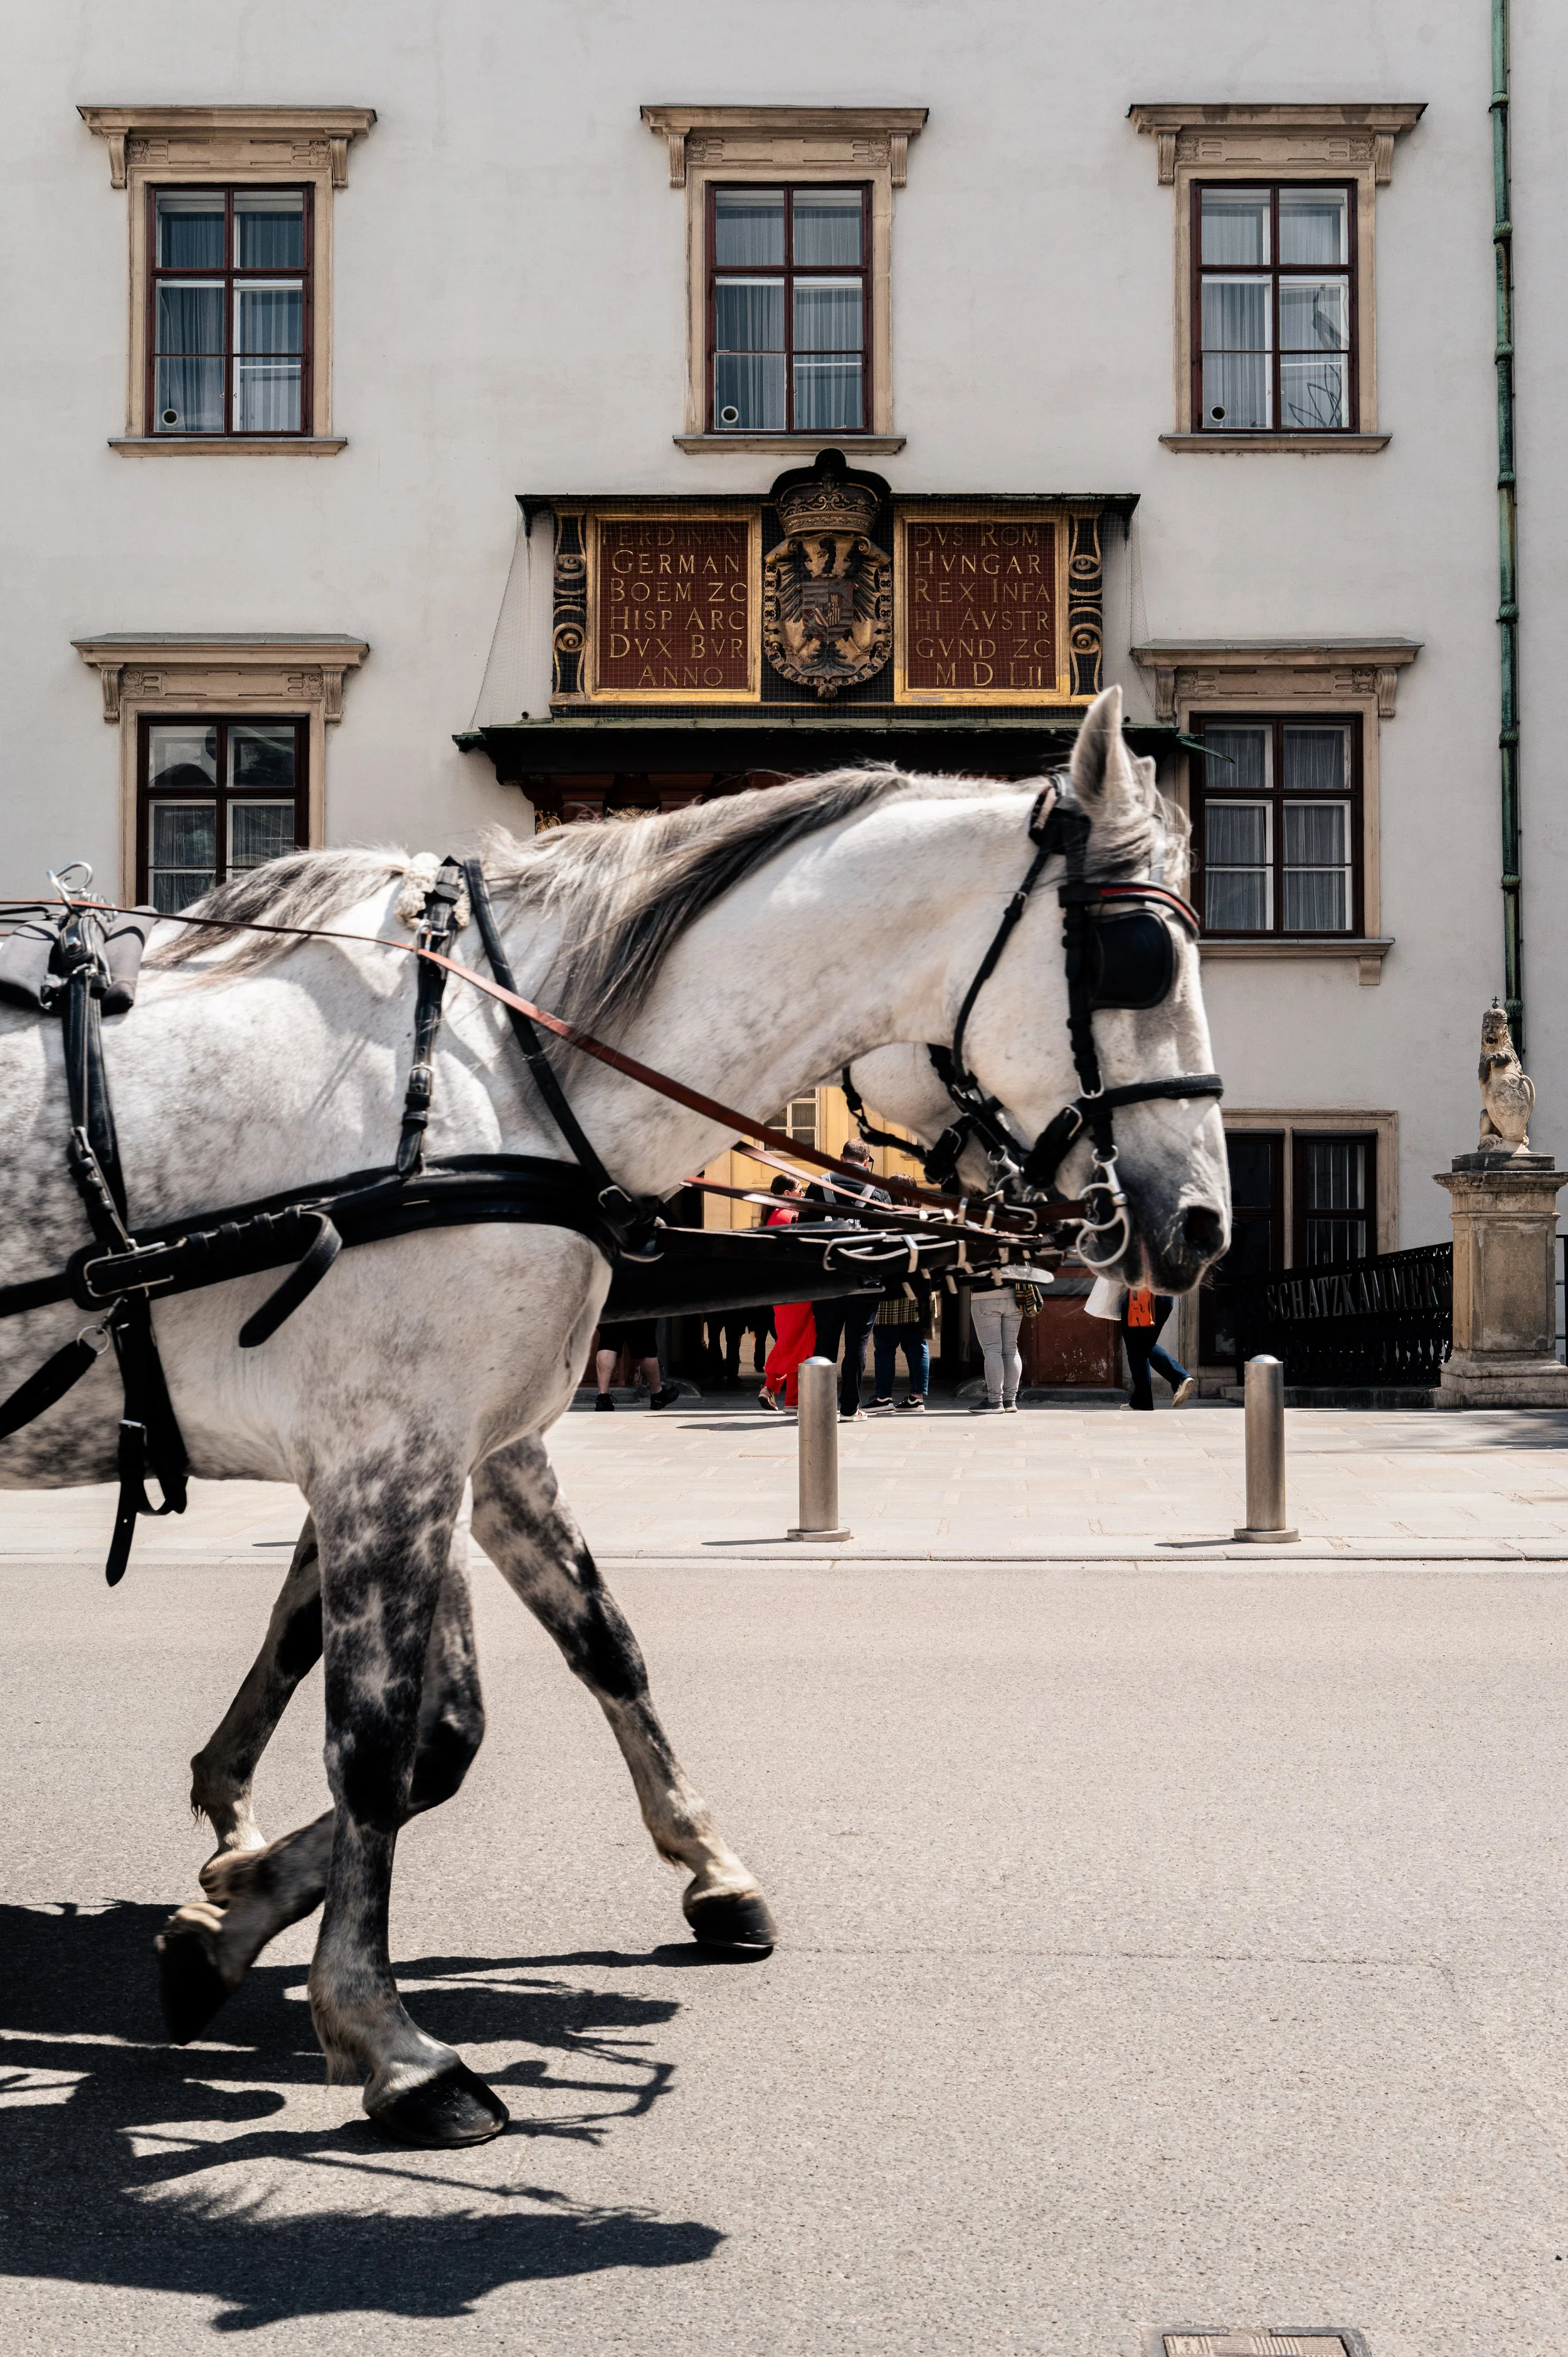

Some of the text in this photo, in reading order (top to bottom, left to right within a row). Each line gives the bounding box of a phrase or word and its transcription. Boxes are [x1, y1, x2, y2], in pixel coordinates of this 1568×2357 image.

[603, 526, 739, 545] FERDINAN
[914, 523, 1037, 546] DVS ROM
[612, 550, 739, 573] GERMAN
[914, 550, 1041, 574] HVNGAR
[610, 578, 747, 602] BOEM ZC
[914, 578, 1051, 602] REX INFA
[610, 606, 745, 630] HISP ARC
[959, 607, 1049, 630] AVSTR
[609, 634, 744, 658] DVX BVR
[916, 638, 1051, 658] GVND ZC
[638, 663, 723, 686] ANNO
[1266, 1262, 1441, 1321] SCHATZKAMMER
